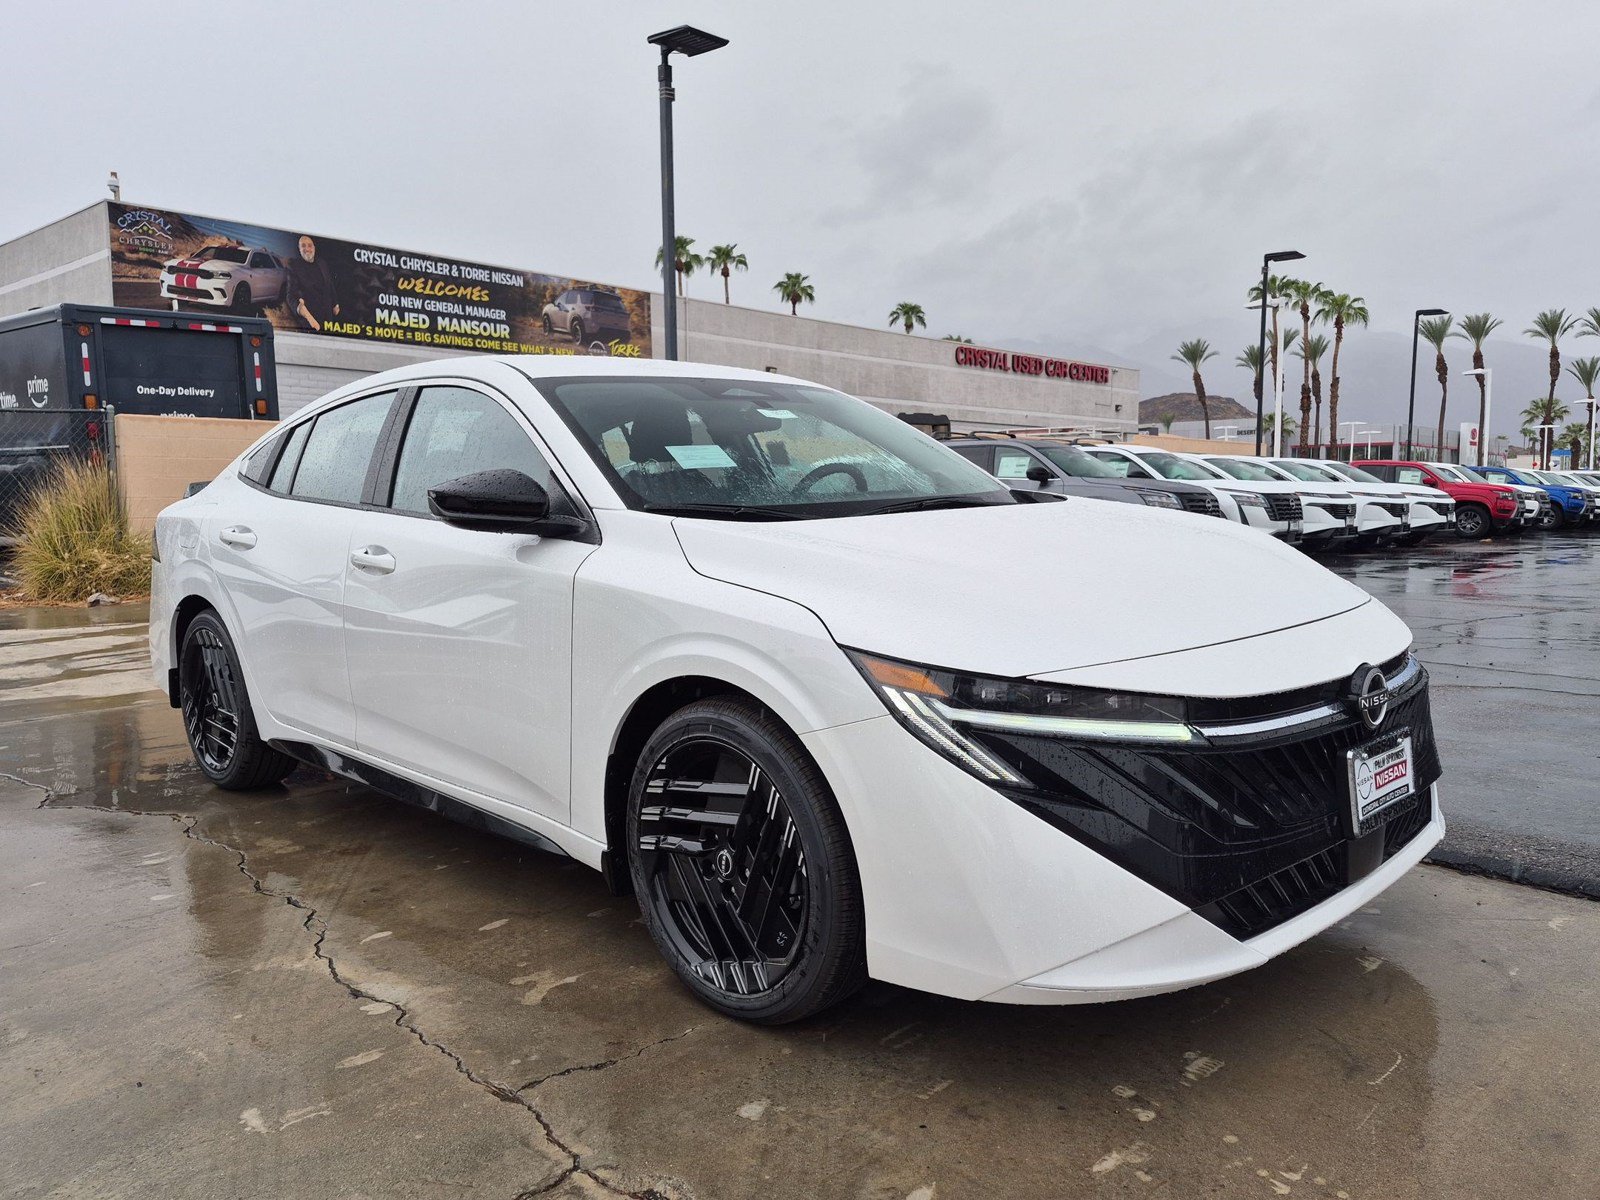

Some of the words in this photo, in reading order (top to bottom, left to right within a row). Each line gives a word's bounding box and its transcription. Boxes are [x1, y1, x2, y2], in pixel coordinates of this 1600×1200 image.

[117, 210, 173, 235] CRYSTAL
[119, 236, 173, 250] CHRYSLER
[353, 248, 399, 268] CRYSTAL
[400, 256, 450, 276] CHRYSLER
[451, 264, 459, 277] &
[460, 266, 490, 282] TORRE
[492, 271, 524, 287] NISSAN
[397, 276, 490, 302] WELCOMES
[379, 293, 399, 307] OUR
[401, 296, 423, 310] NEW
[424, 299, 464, 315] GENERAL
[465, 304, 506, 321] MANAGER
[375, 308, 430, 329] MAJED
[437, 316, 510, 339] MANSOUR
[375, 327, 404, 340] MOVE
[414, 332, 431, 343] BIG
[433, 333, 473, 347] SAVINGS
[475, 339, 501, 350] COME
[502, 341, 519, 352] SEE
[555, 347, 575, 356] NEW
[955, 346, 1010, 372] CRYSTAL
[1012, 354, 1043, 375] USED
[1045, 358, 1068, 378] CAR
[1069, 362, 1109, 384] CENTER
[27, 374, 49, 398] prime
[136, 384, 176, 397] One-Day
[177, 386, 215, 398] Delivery
[1361, 692, 1389, 708] NISS
[1374, 755, 1386, 771] PALM
[1376, 762, 1406, 788] NISSAN
[1357, 774, 1374, 787] NISSAN
